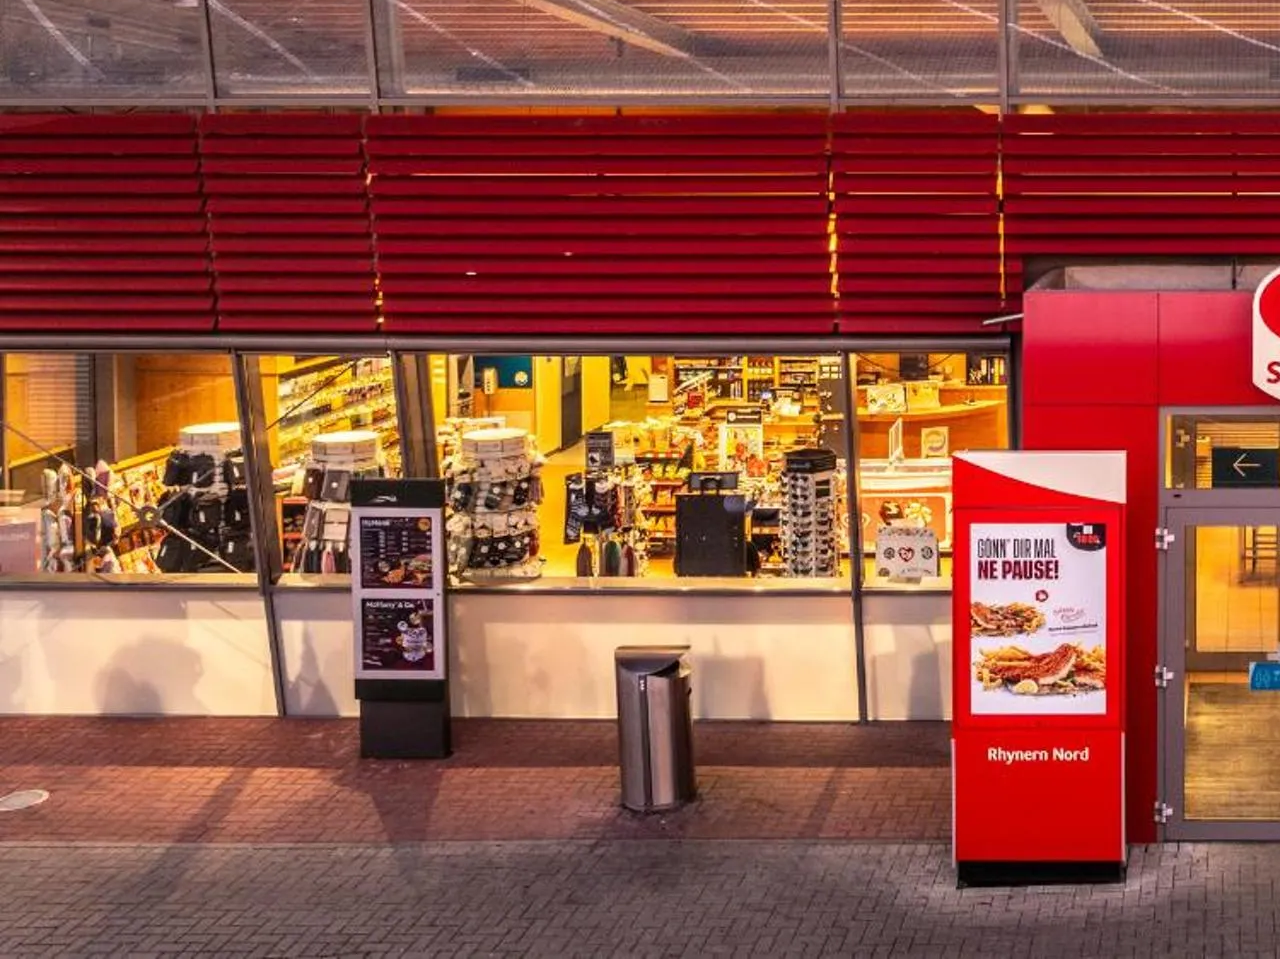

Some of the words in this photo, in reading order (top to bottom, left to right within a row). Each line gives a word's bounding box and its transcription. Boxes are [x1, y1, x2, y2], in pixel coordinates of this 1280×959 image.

[1013, 538, 1032, 559] DIR
[1034, 538, 1057, 559] MAL
[977, 560, 998, 580] NE
[1002, 560, 1059, 580] PAUSE!
[987, 747, 1049, 765] Rhynern
[1052, 747, 1090, 762] Nord
